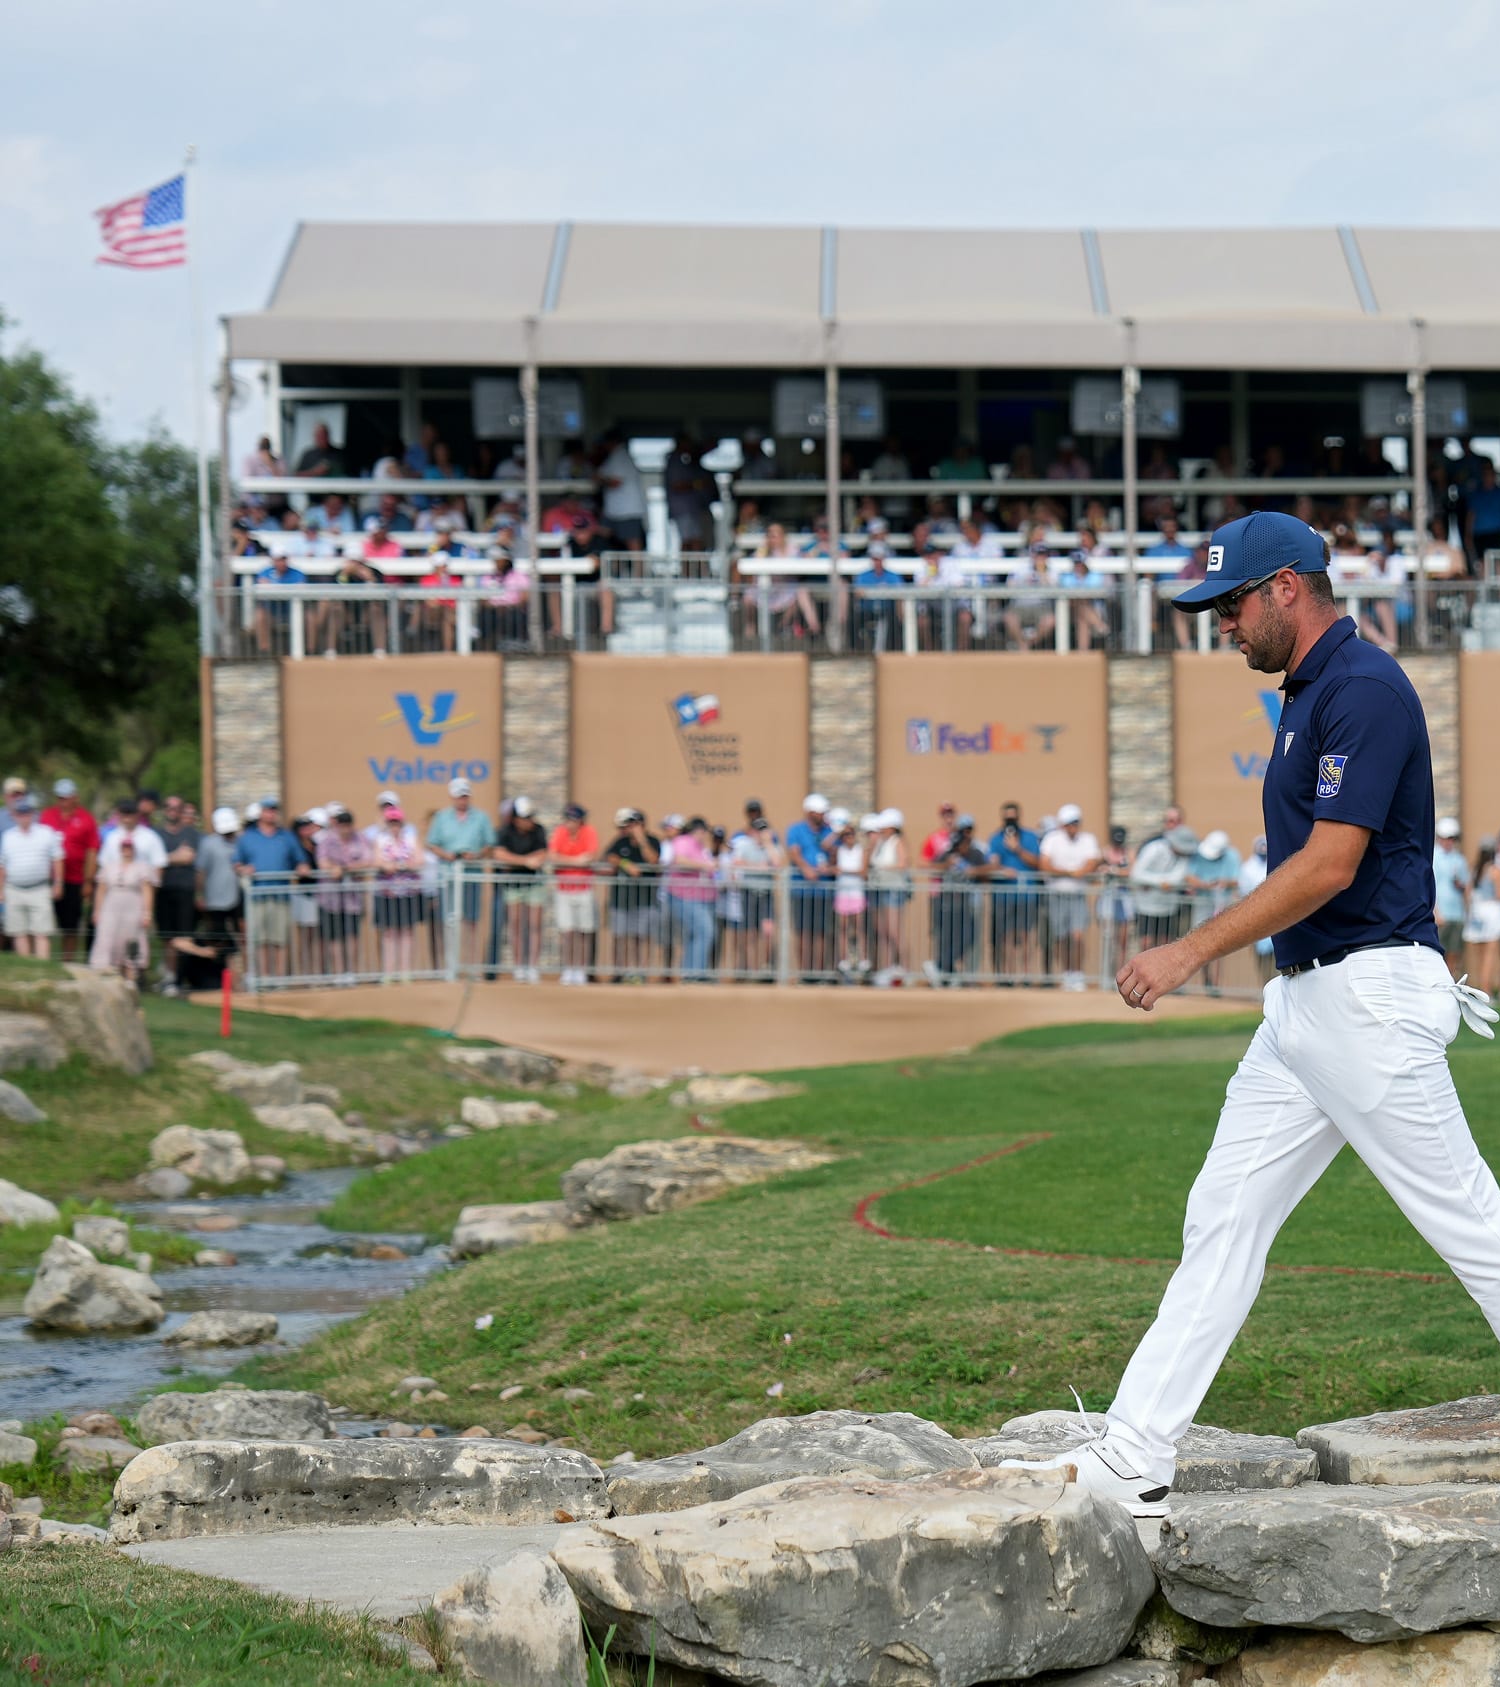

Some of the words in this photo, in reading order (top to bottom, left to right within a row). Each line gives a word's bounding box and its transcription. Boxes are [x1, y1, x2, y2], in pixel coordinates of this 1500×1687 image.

[937, 723, 1027, 755] FedEx
[367, 756, 490, 784] Valero
[1319, 784, 1338, 795] RBC
